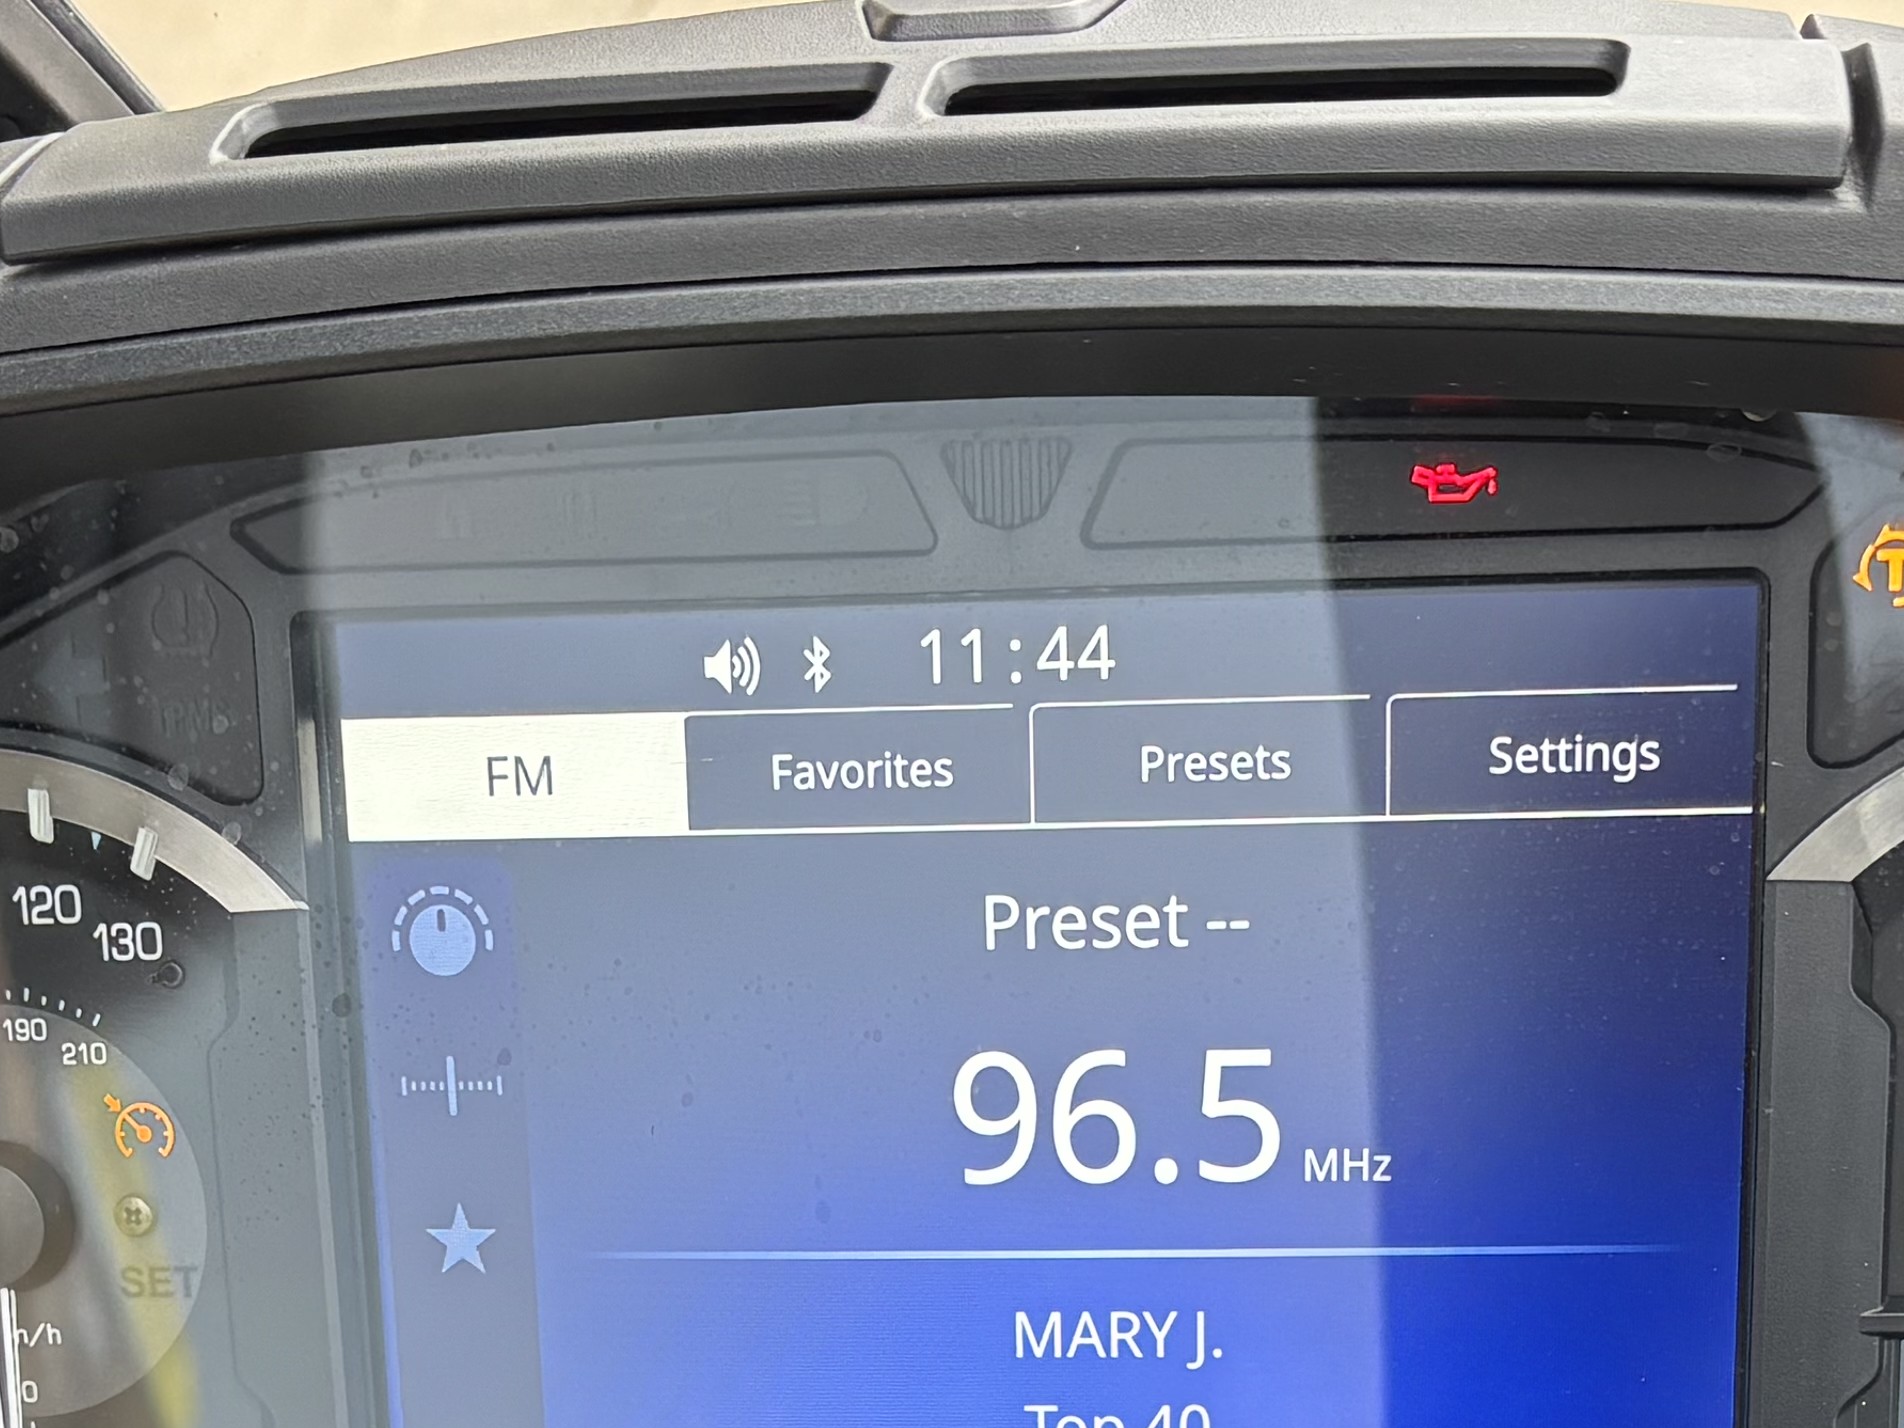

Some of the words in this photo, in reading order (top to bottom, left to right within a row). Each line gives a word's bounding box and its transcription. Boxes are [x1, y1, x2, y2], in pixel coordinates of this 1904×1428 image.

[921, 625, 1116, 684] 11:44
[487, 756, 552, 796] FM
[772, 751, 953, 790] Favorites
[1142, 745, 1291, 782] Presets
[1489, 734, 1660, 782] Settings
[13, 885, 81, 925] 120
[985, 895, 1189, 950] Preset
[93, 922, 162, 961] 130
[3, 1018, 47, 1041] 190
[62, 1042, 106, 1065] 210
[954, 1049, 1280, 1185] 96.5
[1305, 1148, 1392, 1182] MHz
[121, 1266, 198, 1298] SET
[1015, 1310, 1178, 1359] MARY
[1185, 1310, 1223, 1370] J.
